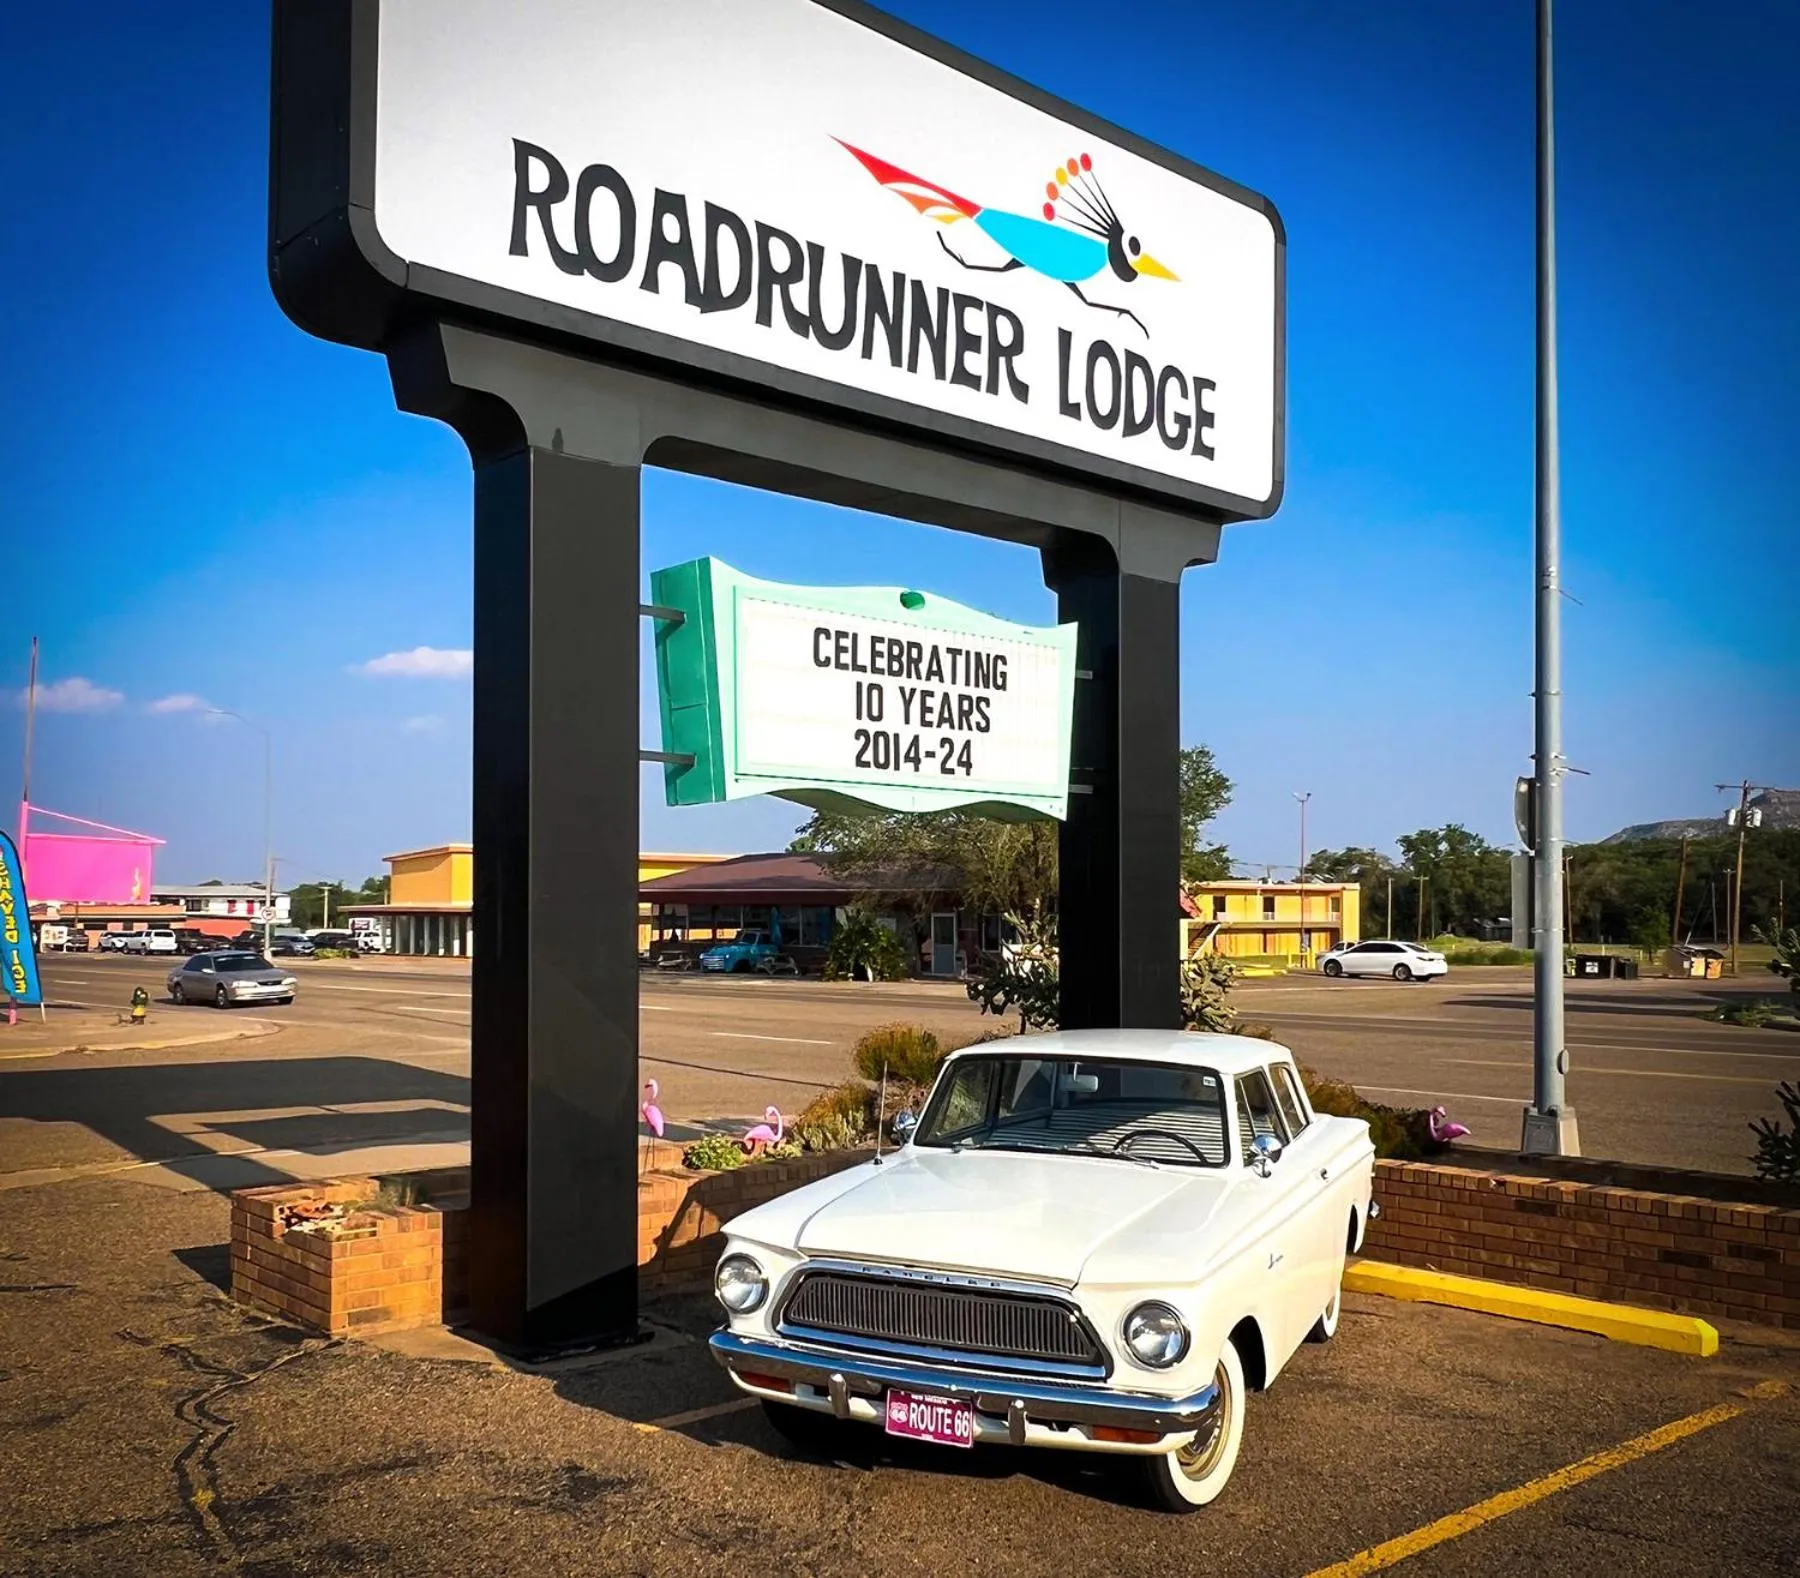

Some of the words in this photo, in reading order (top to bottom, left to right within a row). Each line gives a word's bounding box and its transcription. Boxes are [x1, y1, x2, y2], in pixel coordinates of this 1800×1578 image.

[510, 138, 1029, 404] ROADRUNNER
[1058, 327, 1217, 461] LODGE
[813, 627, 1008, 692] CELEBRATING
[856, 681, 883, 722] 10
[899, 686, 991, 733] YEARS
[854, 729, 973, 776] 2014-24
[909, 1402, 953, 1435] ROUTE
[954, 1409, 970, 1438] 66
